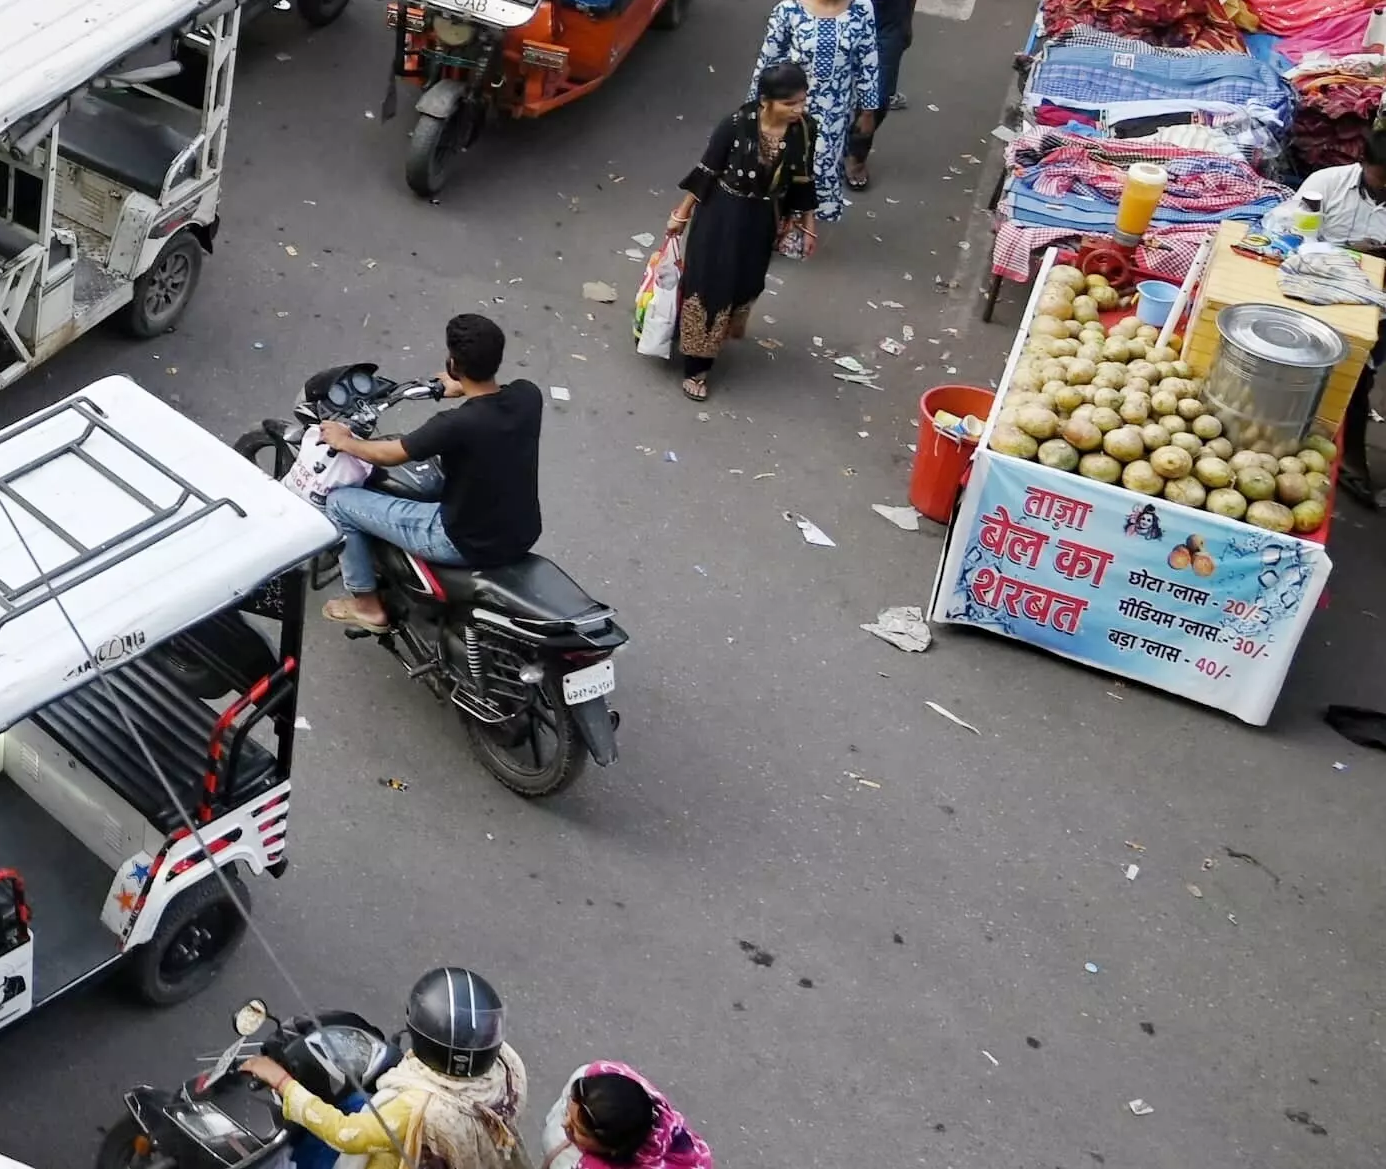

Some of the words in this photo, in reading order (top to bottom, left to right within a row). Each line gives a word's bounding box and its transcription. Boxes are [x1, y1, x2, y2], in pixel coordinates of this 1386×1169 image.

[1023, 485, 1094, 532] ताज़ा
[979, 504, 1050, 570] बेल
[1054, 538, 1115, 588] का
[970, 568, 1088, 636] शरबत
[1128, 569, 1165, 595] छोटा
[1166, 583, 1212, 608] ग्लास
[1108, 629, 1137, 654] बड़ा
[1138, 640, 1182, 665] ग्लास
[1194, 657, 1233, 682] 40/-
[1117, 598, 1175, 628] मीडियम
[1175, 616, 1221, 643] ग्लास
[1232, 637, 1270, 660] 30/-
